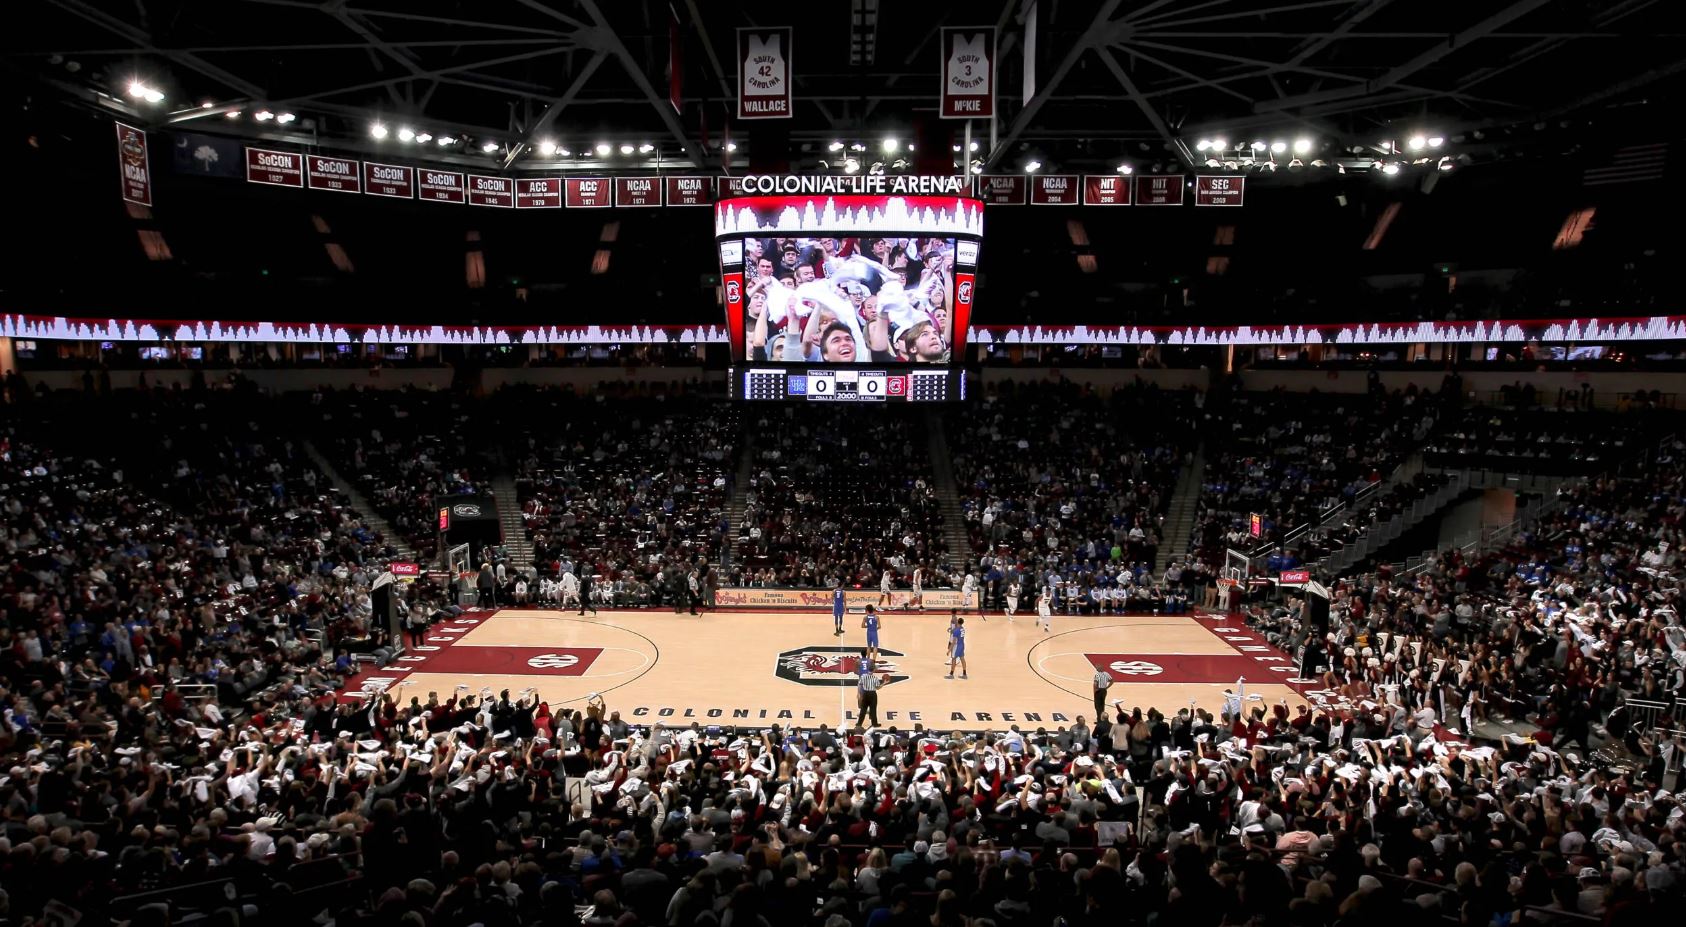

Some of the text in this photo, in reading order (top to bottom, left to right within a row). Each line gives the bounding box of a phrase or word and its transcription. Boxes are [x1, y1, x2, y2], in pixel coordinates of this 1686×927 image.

[754, 54, 776, 65] SOUTH
[957, 54, 980, 64] SOUTH
[758, 66, 771, 77] 42
[965, 65, 972, 76] 3
[748, 76, 781, 89] CAROLINA
[951, 76, 985, 89] CAROLINA
[744, 100, 786, 112] WALLACE
[257, 152, 292, 168] SoCON
[317, 160, 350, 174] SoCON
[124, 163, 147, 183] NCAA
[374, 167, 404, 181] SoCON
[427, 173, 455, 186] SoCON
[678, 179, 701, 190] NCAA
[742, 175, 844, 193] COLONIAL
[852, 175, 886, 193] LIFE
[892, 175, 960, 193] ARENA
[990, 178, 1014, 188] NCAA
[1043, 178, 1067, 189] NCAA
[1100, 178, 1115, 189] NIT
[1152, 179, 1167, 189] NIT
[1212, 179, 1229, 190] SEC
[477, 179, 505, 192] SoCON
[530, 182, 547, 192] ACC
[580, 181, 597, 192] ACC
[627, 180, 651, 191] NCAA
[816, 380, 826, 392] 0
[867, 380, 878, 393] 0
[632, 707, 1069, 723] COLONIAL LFE ARENA
